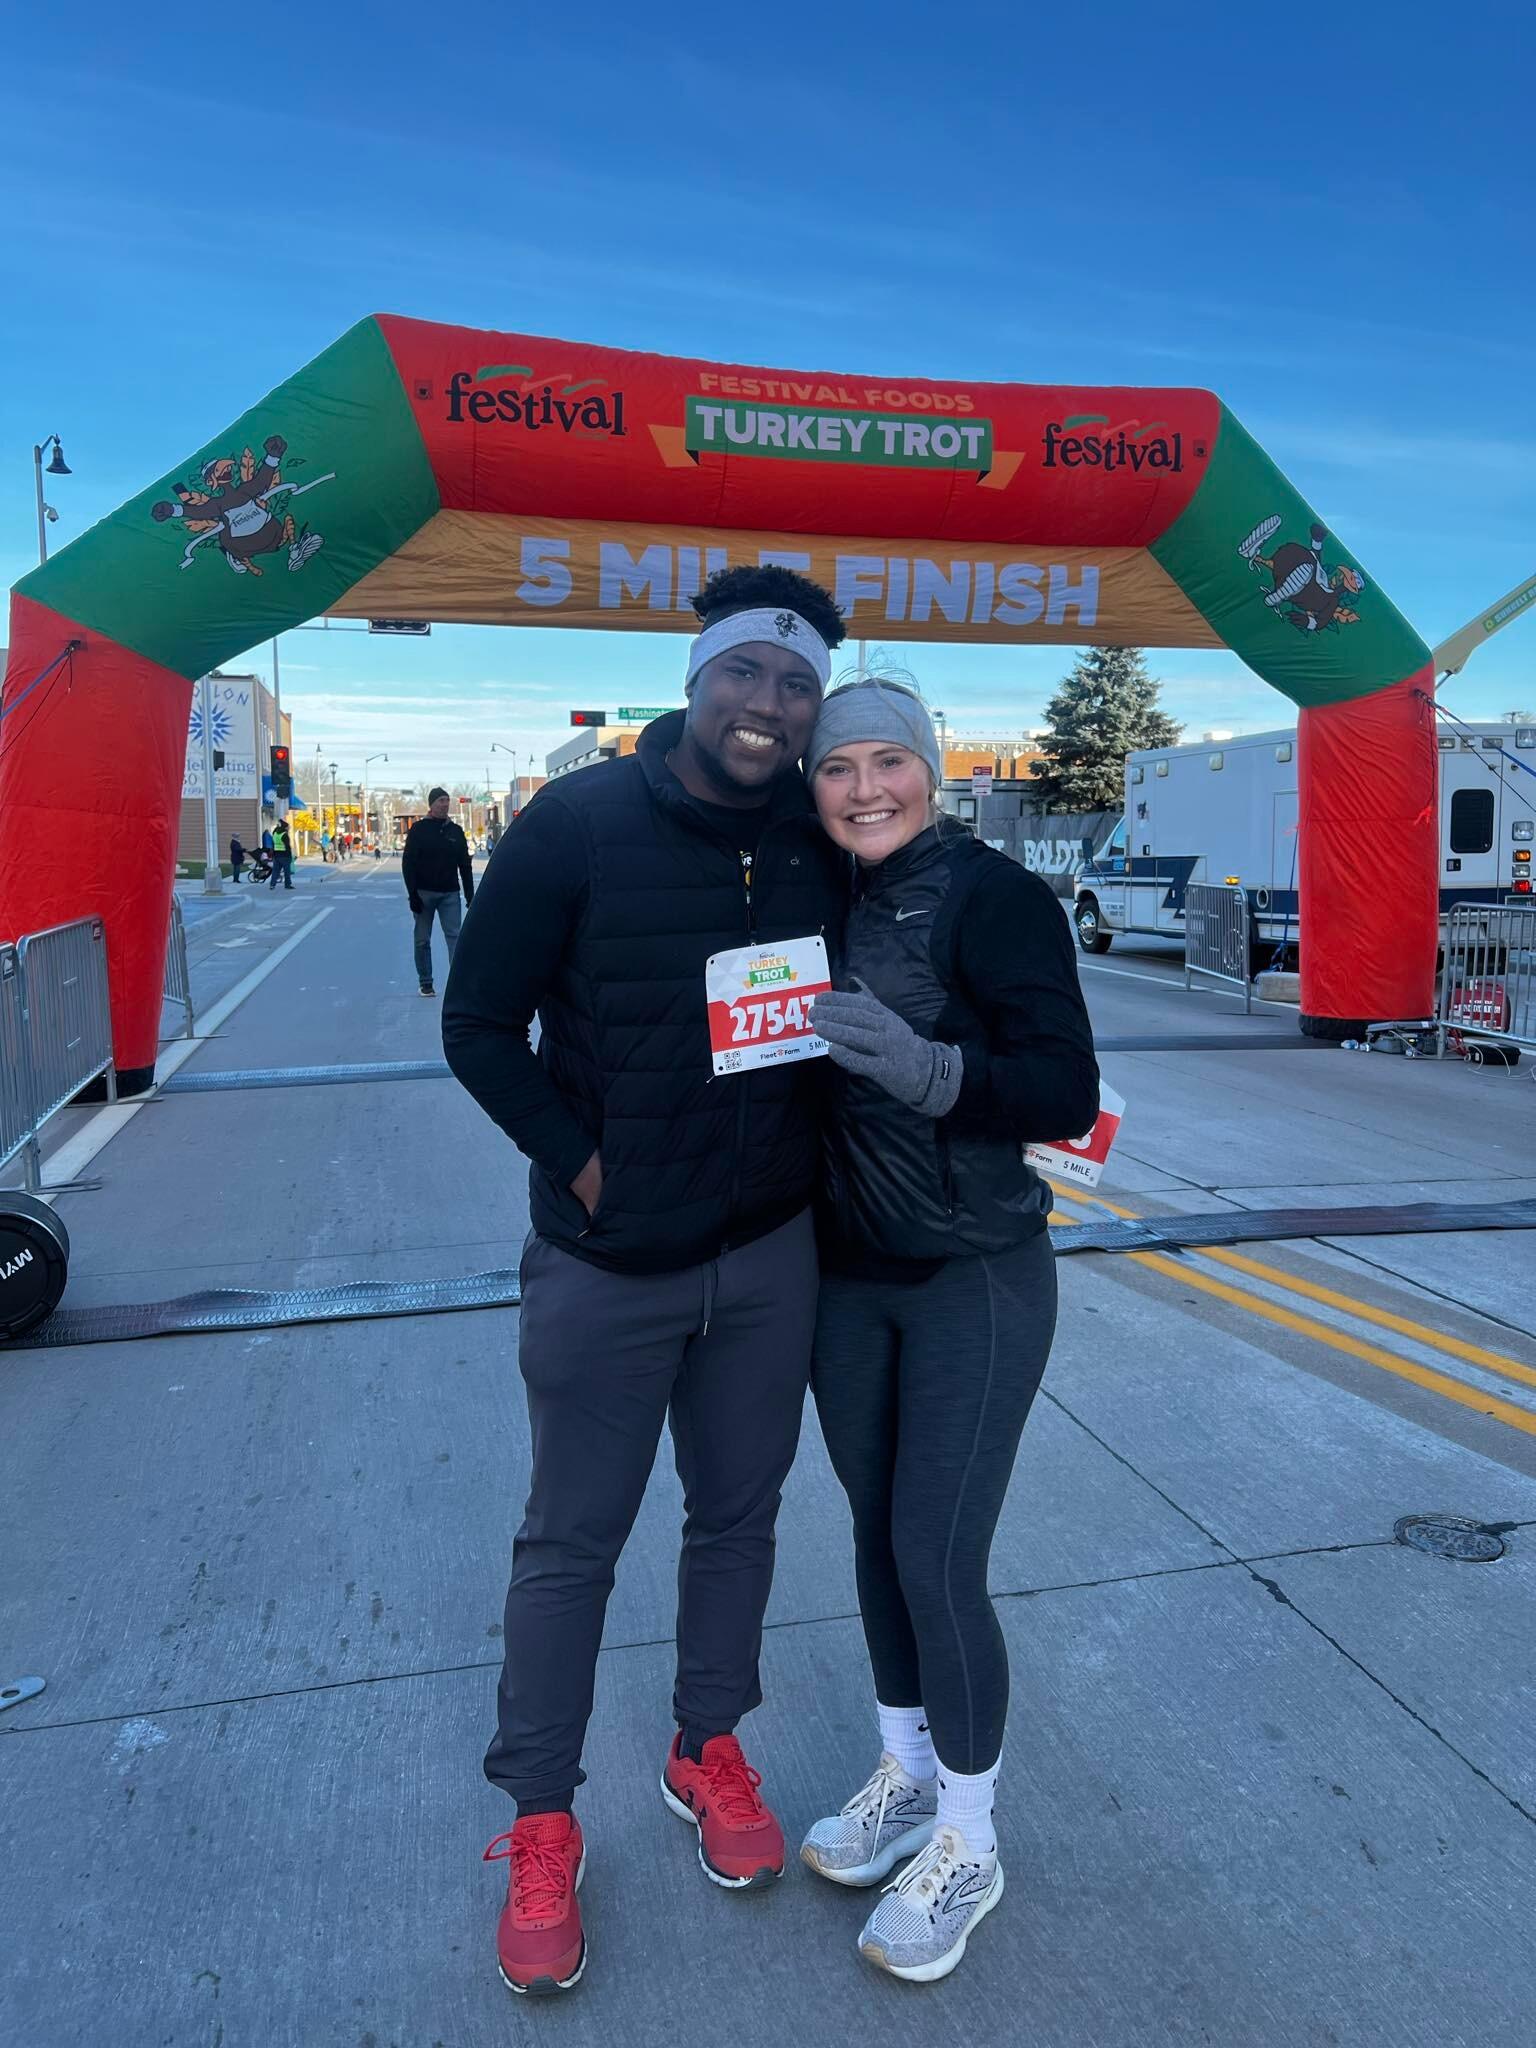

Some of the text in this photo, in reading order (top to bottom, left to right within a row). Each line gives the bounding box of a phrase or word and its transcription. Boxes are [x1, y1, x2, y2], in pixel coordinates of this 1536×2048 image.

[445, 372, 627, 436] festival
[700, 373, 975, 412] FESTIVAL FOODS
[695, 405, 985, 459] TURKEY TROT
[1041, 422, 1184, 473] festival
[514, 536, 573, 607] 5
[834, 555, 1100, 626] FINISH
[1024, 840, 1083, 875] BOLDT
[748, 956, 788, 969] TURKEY
[755, 968, 785, 982] TROT
[760, 1047, 801, 1060] Fleet Farm
[808, 1040, 830, 1051] 5 MIL
[1035, 1153, 1053, 1164] Farm
[1063, 1160, 1092, 1177] 5 MILE
